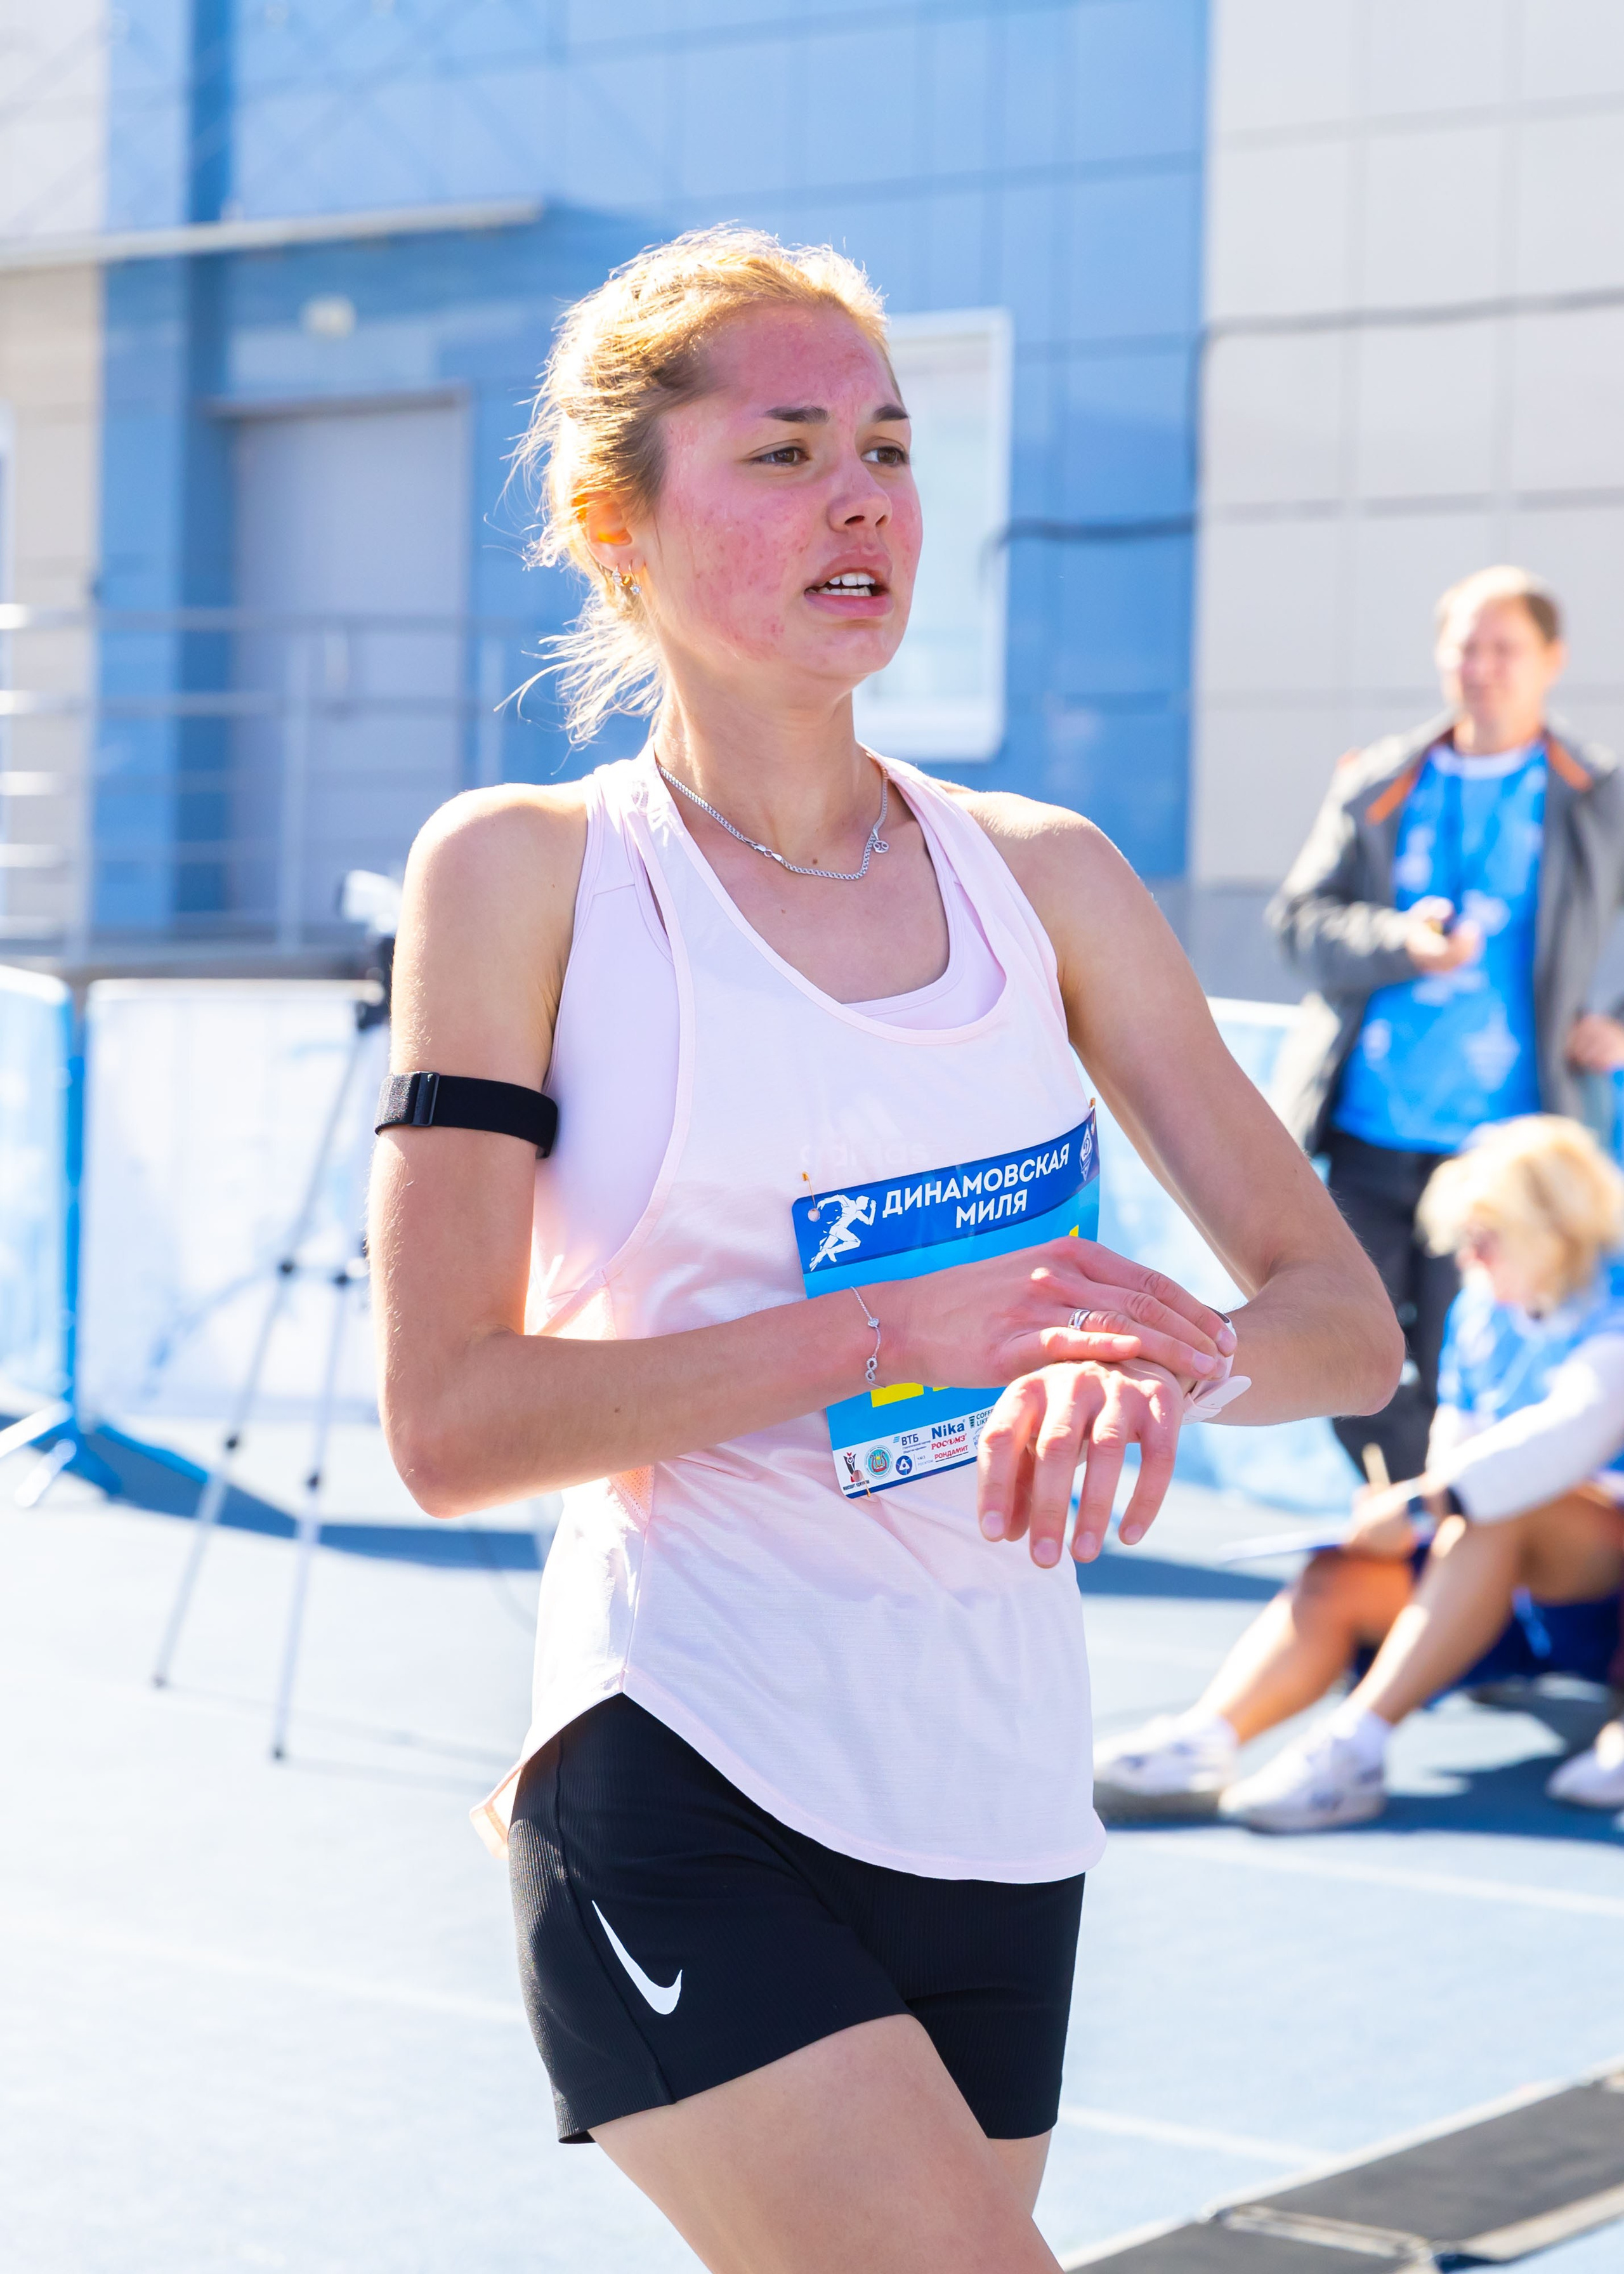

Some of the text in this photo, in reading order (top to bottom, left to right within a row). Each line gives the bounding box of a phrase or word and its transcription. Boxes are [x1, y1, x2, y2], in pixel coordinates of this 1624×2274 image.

[882, 1143, 1070, 1218] ДИНАМОВСКАЯ
[956, 1189, 1028, 1228] МИЛЯ
[901, 1433, 919, 1445] ВТБ
[931, 1423, 965, 1439] Nika
[934, 1445, 968, 1459] РОНДАМИТ
